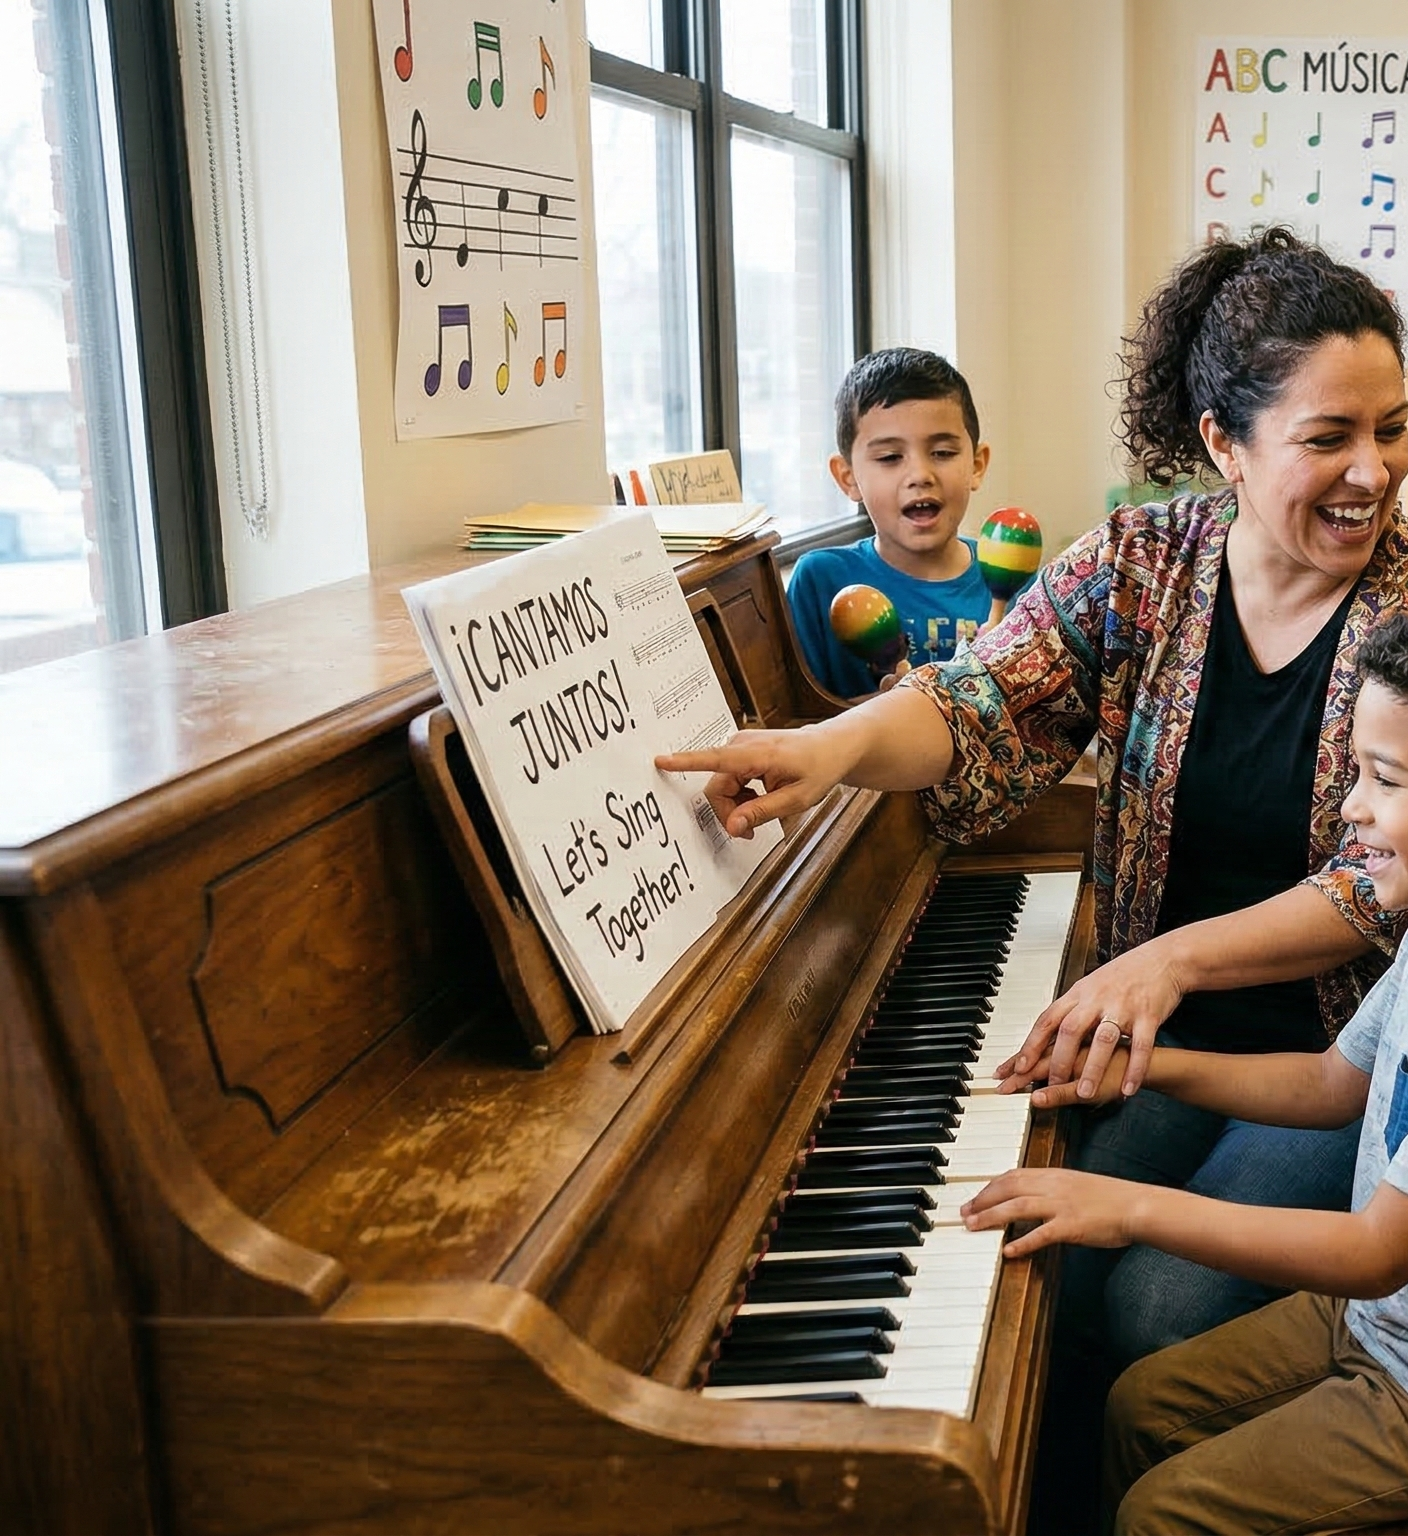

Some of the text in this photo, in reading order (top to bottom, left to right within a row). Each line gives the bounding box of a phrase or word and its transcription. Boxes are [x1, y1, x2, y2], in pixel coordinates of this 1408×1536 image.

[1204, 48, 1288, 94] ABC
[1206, 112, 1231, 143] A
[1206, 167, 1226, 199] C
[449, 576, 609, 707] ¡CANTAMOS
[510, 659, 636, 785] JUNTOS!
[543, 790, 670, 898] Let's Sing
[586, 839, 695, 962] Together!
